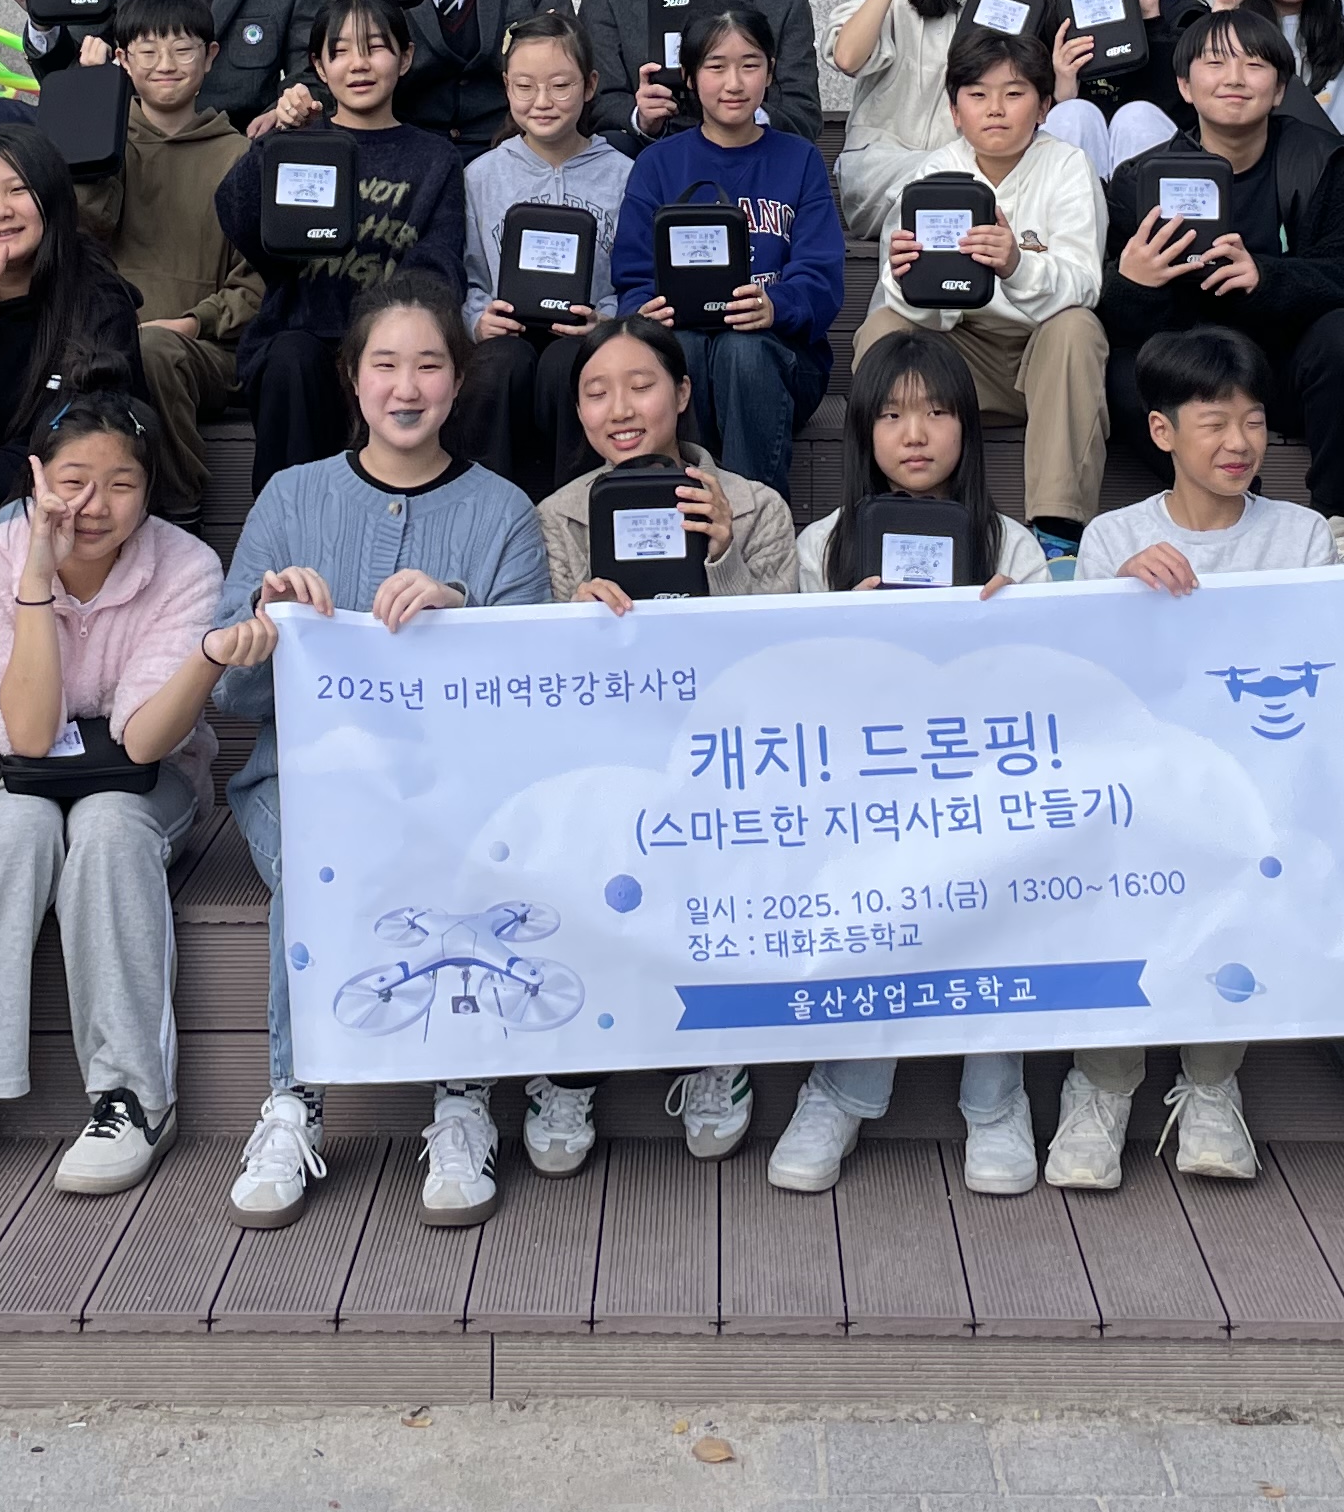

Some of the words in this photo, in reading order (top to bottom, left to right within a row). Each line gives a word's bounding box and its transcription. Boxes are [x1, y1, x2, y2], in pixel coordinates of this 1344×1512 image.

[316, 674, 425, 710] 2025년
[443, 666, 698, 710] 미래역량강화사업
[689, 722, 833, 791] 캐치!
[858, 711, 1064, 780] 드론핑!
[635, 804, 810, 856] (스마트한
[824, 794, 984, 845] 지역사회
[998, 783, 1135, 832] 만들기)
[686, 895, 737, 926] 일시
[762, 892, 840, 922] 2025.
[850, 888, 894, 916] 10.
[900, 878, 989, 915] 31.(금)
[1007, 869, 1187, 904] 13:00~16:00
[688, 931, 740, 963] 장소
[764, 922, 923, 959] 태화초등학교
[786, 974, 1038, 1021] 울산상업고등학교
